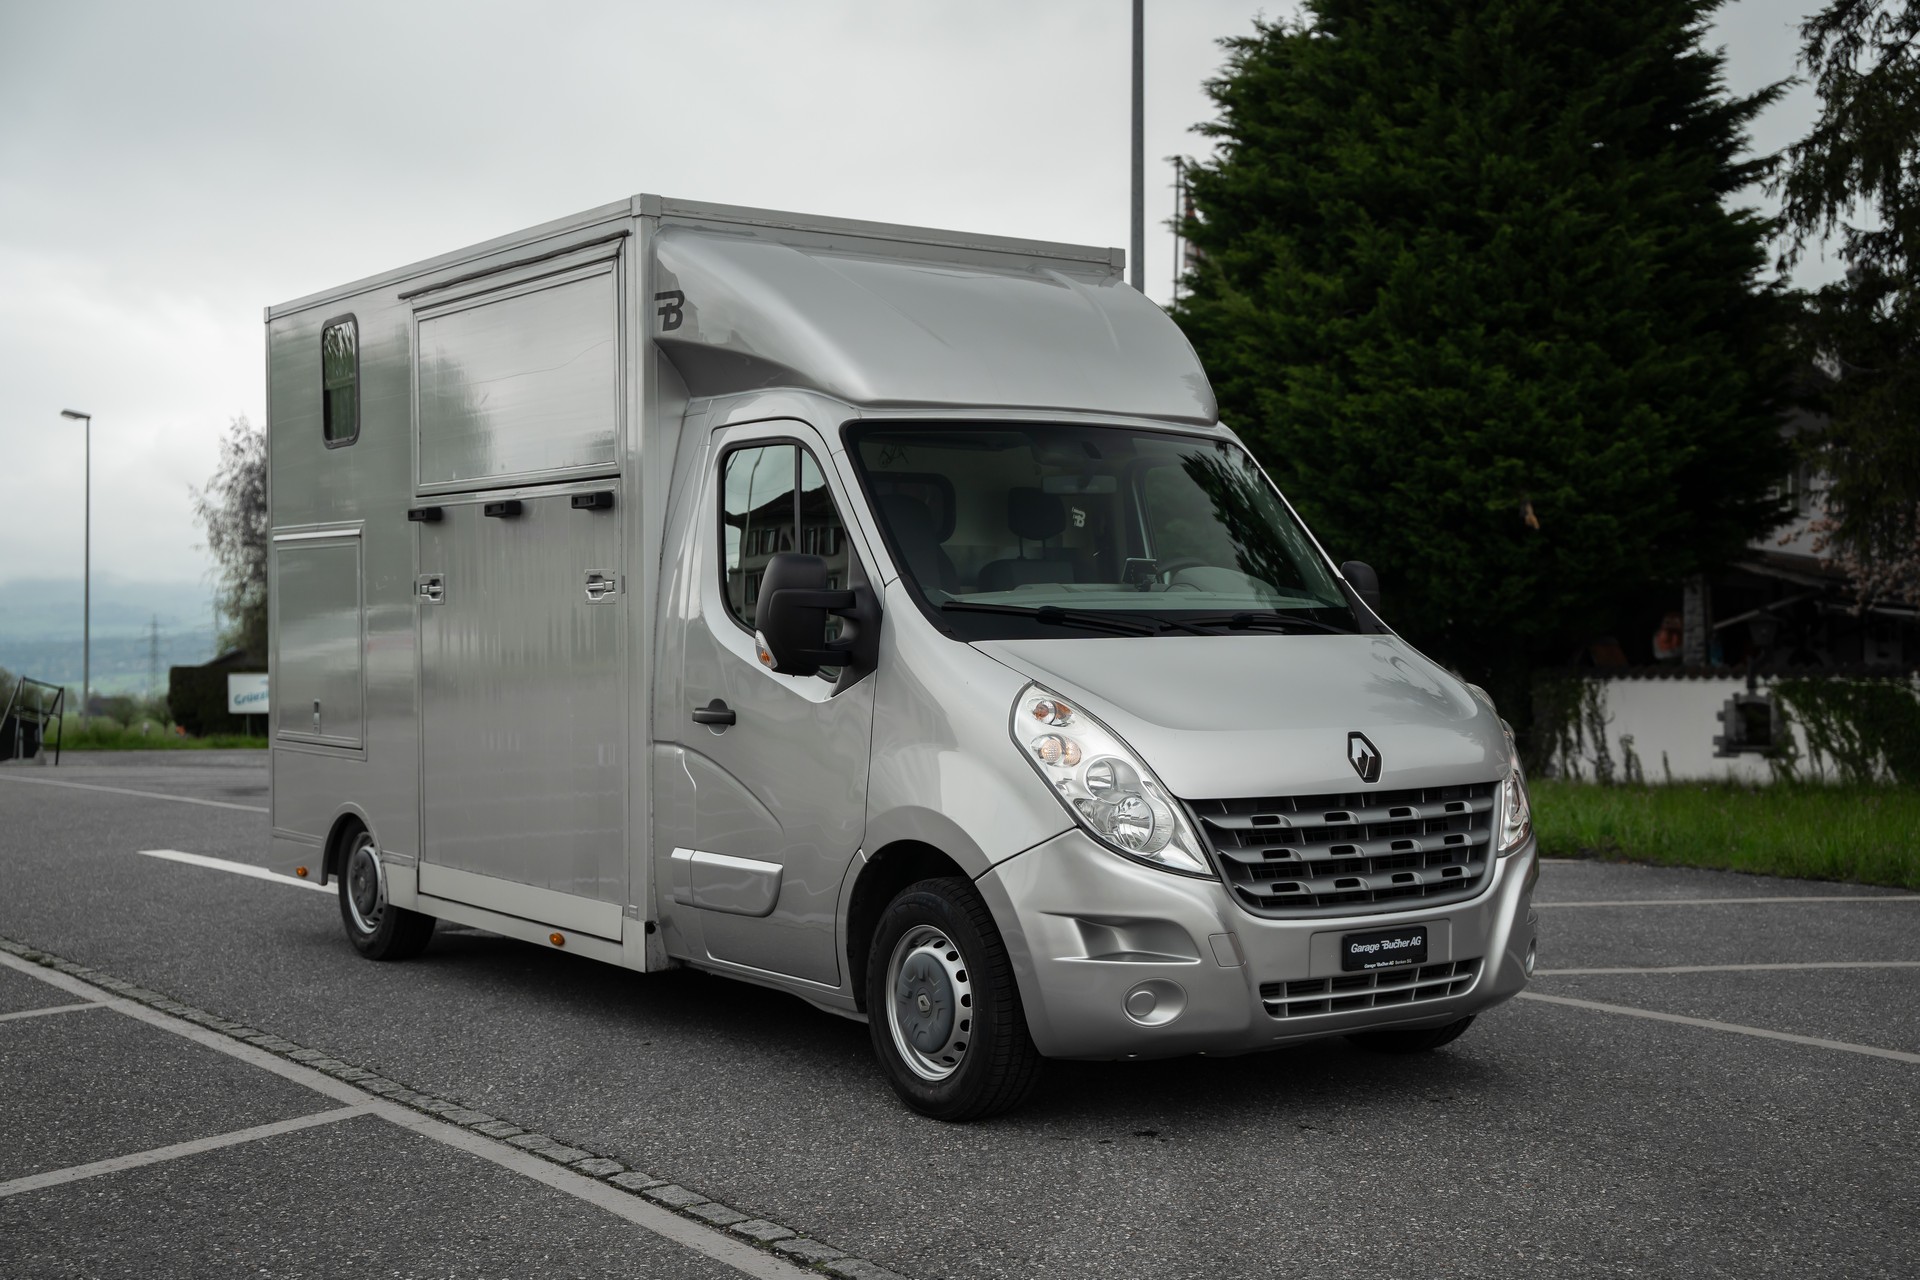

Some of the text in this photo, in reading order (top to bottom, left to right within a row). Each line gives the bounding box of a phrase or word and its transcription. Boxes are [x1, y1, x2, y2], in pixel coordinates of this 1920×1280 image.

[1351, 936, 1422, 953] Garage Bucher AG
